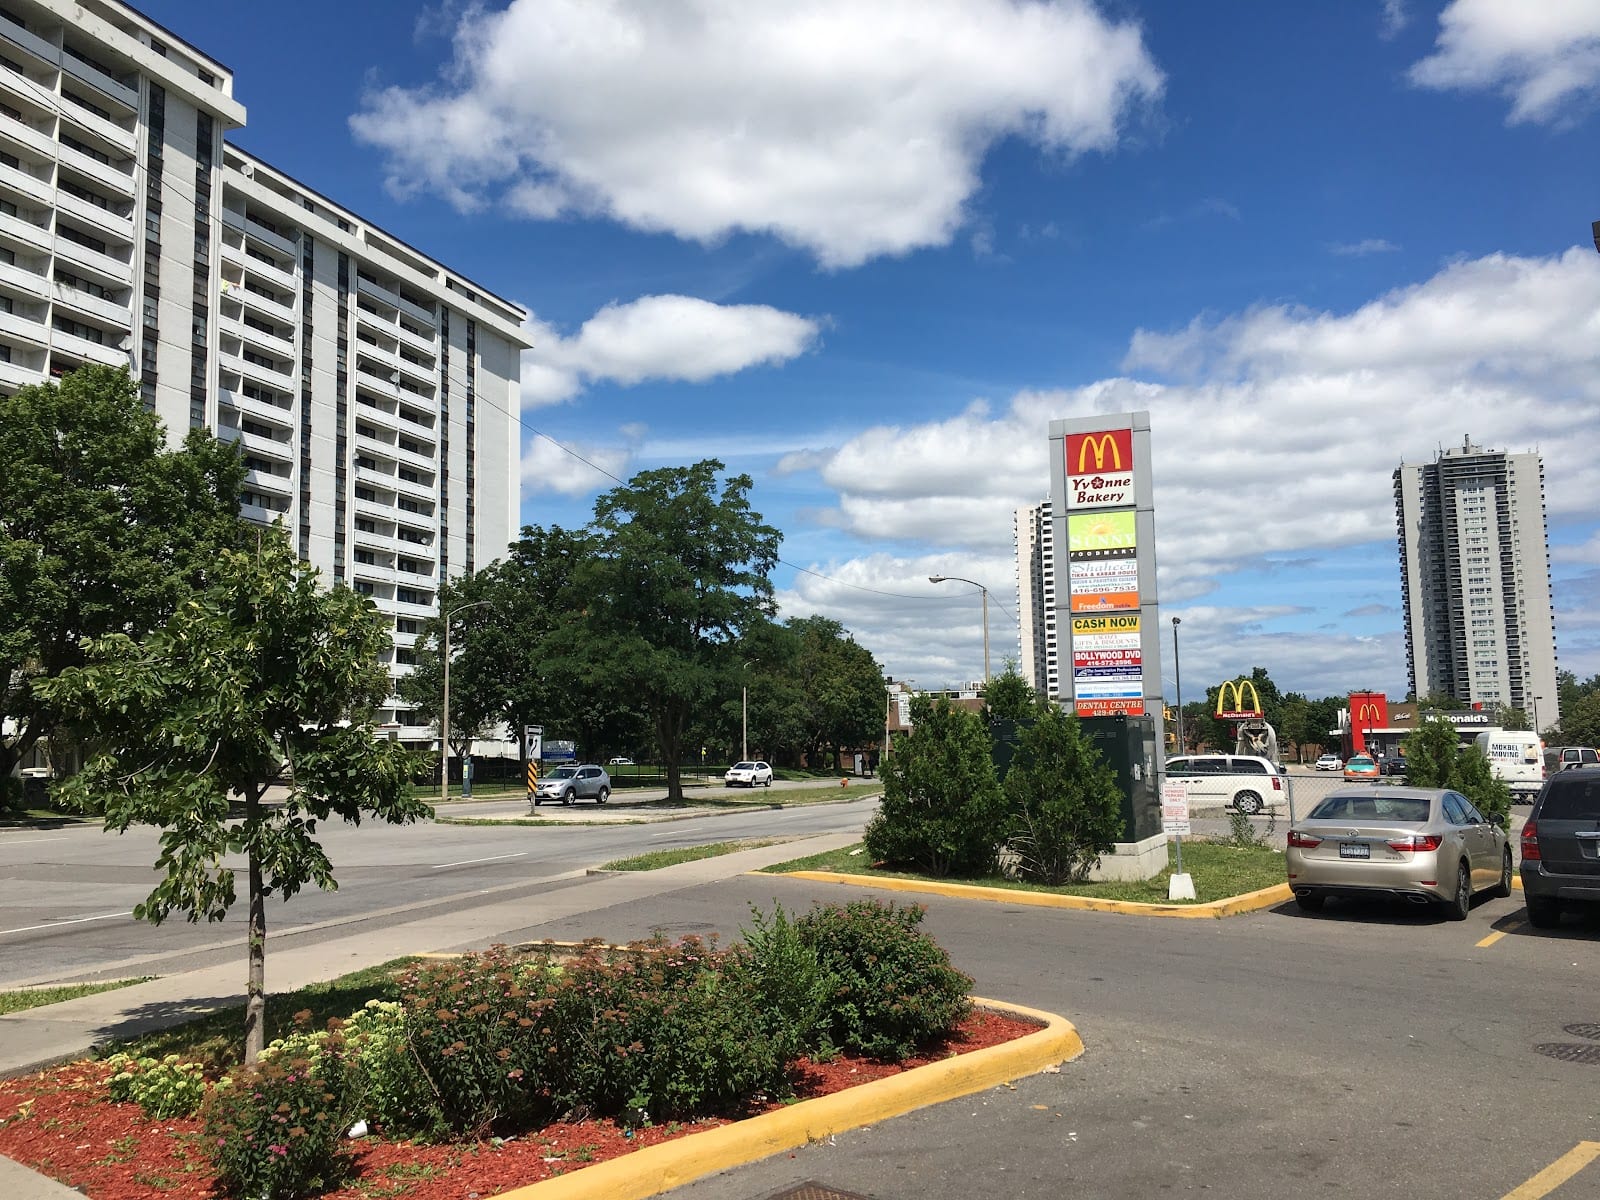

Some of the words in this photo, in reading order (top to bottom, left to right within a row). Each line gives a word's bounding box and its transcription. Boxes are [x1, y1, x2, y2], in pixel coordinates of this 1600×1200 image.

[1072, 476, 1131, 491] Yvonne
[1076, 491, 1124, 504] Bakery
[1071, 534, 1133, 548] SUNNY
[1070, 562, 1135, 574] Shaheen
[1079, 602, 1114, 610] Freedom
[1074, 618, 1106, 629] CASH
[1110, 616, 1138, 627] NOW
[1075, 651, 1123, 660] BOLLYWOOD
[1077, 701, 1108, 710] DENTAL
[1110, 700, 1143, 709] CENTRE
